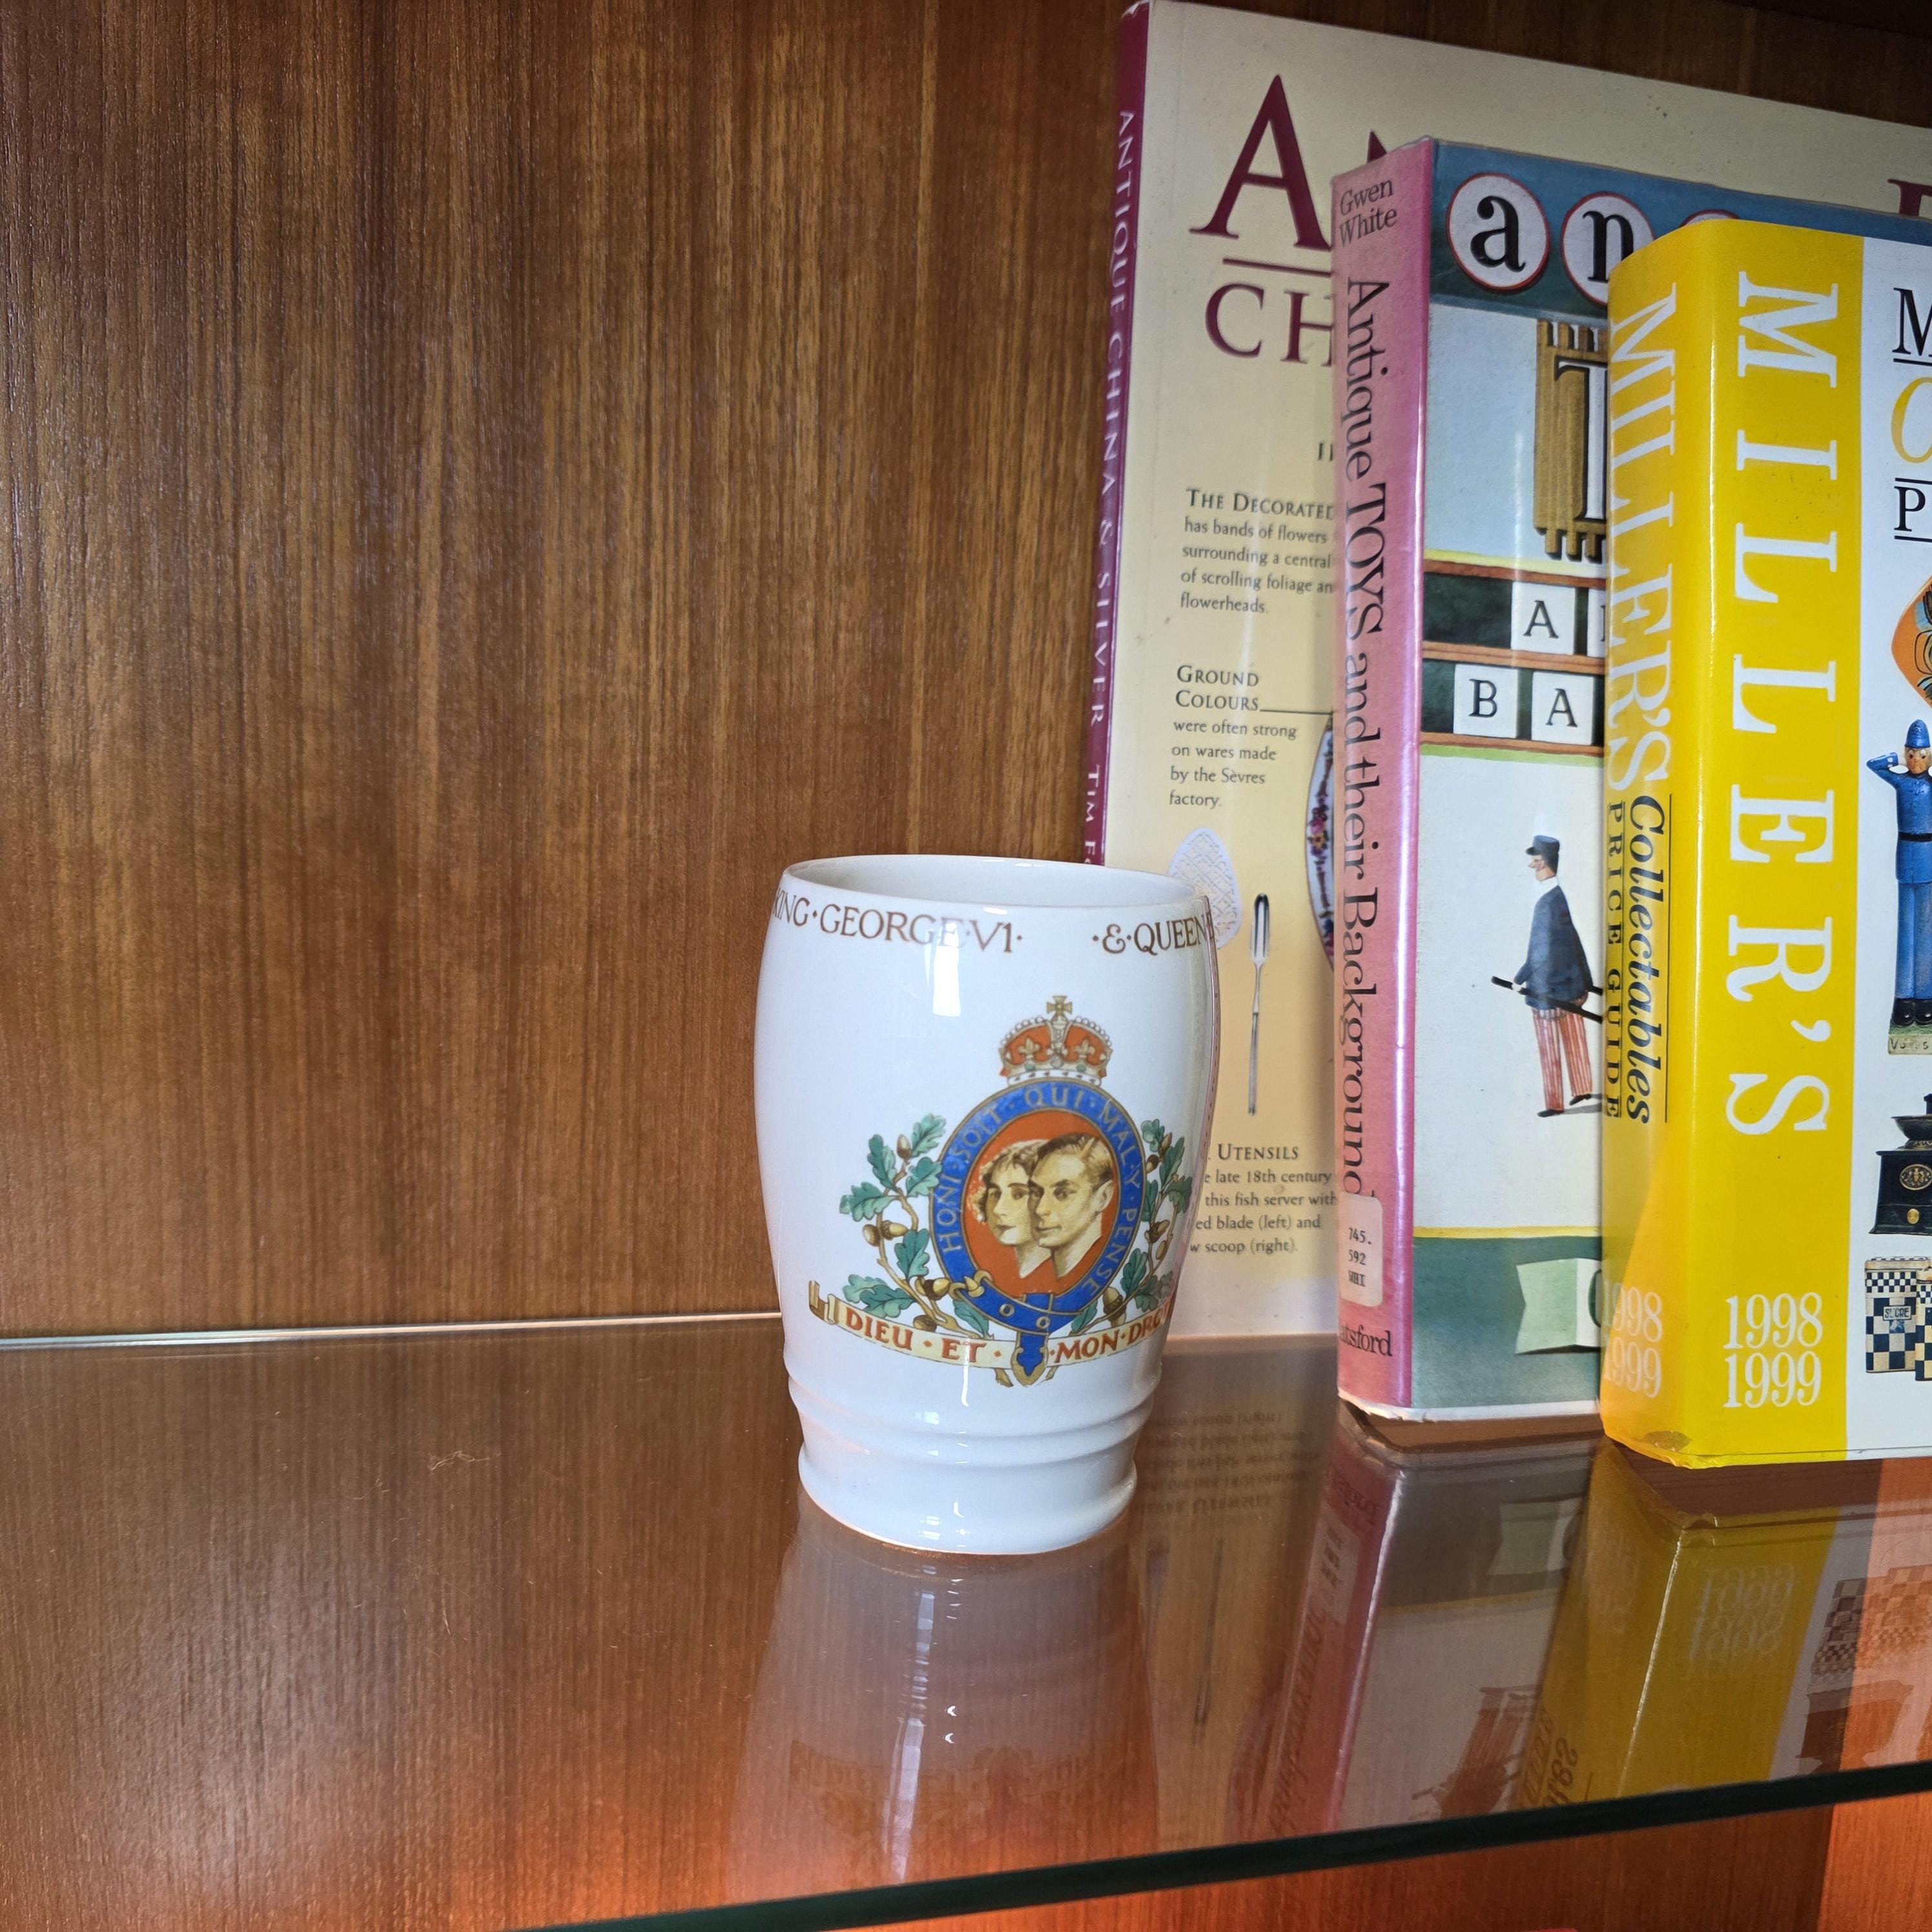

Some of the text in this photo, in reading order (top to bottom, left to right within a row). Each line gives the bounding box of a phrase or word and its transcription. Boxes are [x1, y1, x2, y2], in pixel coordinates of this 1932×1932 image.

[1110, 110, 1135, 314] ANTIQUE
[1339, 180, 1393, 217] Gwen
[1339, 207, 1398, 248] White
[1341, 276, 1390, 482] Antique
[1102, 332, 1123, 495] CHINA
[1187, 488, 1224, 510] THE
[1184, 516, 1328, 544] has bands of flowers
[1608, 282, 1677, 792] MILLER'S
[1182, 546, 1332, 570] surrounding a central
[1345, 482, 1388, 641] TOYS
[1180, 567, 1198, 584] of
[1201, 570, 1262, 591] scrolling
[1267, 573, 1313, 595] foliage
[1180, 591, 1269, 613] flowerheads.
[1177, 664, 1260, 687] GROUND
[1175, 690, 1259, 711] COLOURS
[1342, 652, 1381, 751] and
[1726, 271, 1838, 1135] MILLER'S
[1173, 719, 1297, 741] were often strong
[1171, 746, 1277, 761] on wares made
[1170, 765, 1266, 785] by the Sèvres
[1085, 765, 1100, 823] TIM
[1169, 790, 1222, 810] factory.
[1342, 756, 1380, 881] their
[1605, 802, 1623, 1118] PRICE GUIDE
[1626, 795, 1666, 1125] Collectables
[1218, 1143, 1299, 1160] UTENSILS
[1216, 1169, 1240, 1184] late
[1247, 1168, 1276, 1184] 18th
[1280, 1172, 1332, 1184] century
[934, 1086, 1141, 1297] HONI SOIT QUI MAL Y PENSE
[1205, 1192, 1229, 1206] this
[1235, 1191, 1259, 1206] fish
[1264, 1195, 1304, 1206] server
[1217, 1215, 1253, 1229] blade
[1259, 1214, 1291, 1231] (left)
[1297, 1214, 1321, 1229] and
[1348, 1227, 1372, 1245] 745.
[1205, 1241, 1245, 1255] scoop
[1348, 1249, 1366, 1266] 592
[1348, 1269, 1366, 1287] WHI
[1723, 1292, 1823, 1349] 1998
[845, 1306, 914, 1351] DIEU
[941, 1337, 987, 1364] ET
[1054, 1330, 1120, 1364] MON
[1722, 1351, 1822, 1408] 1999
